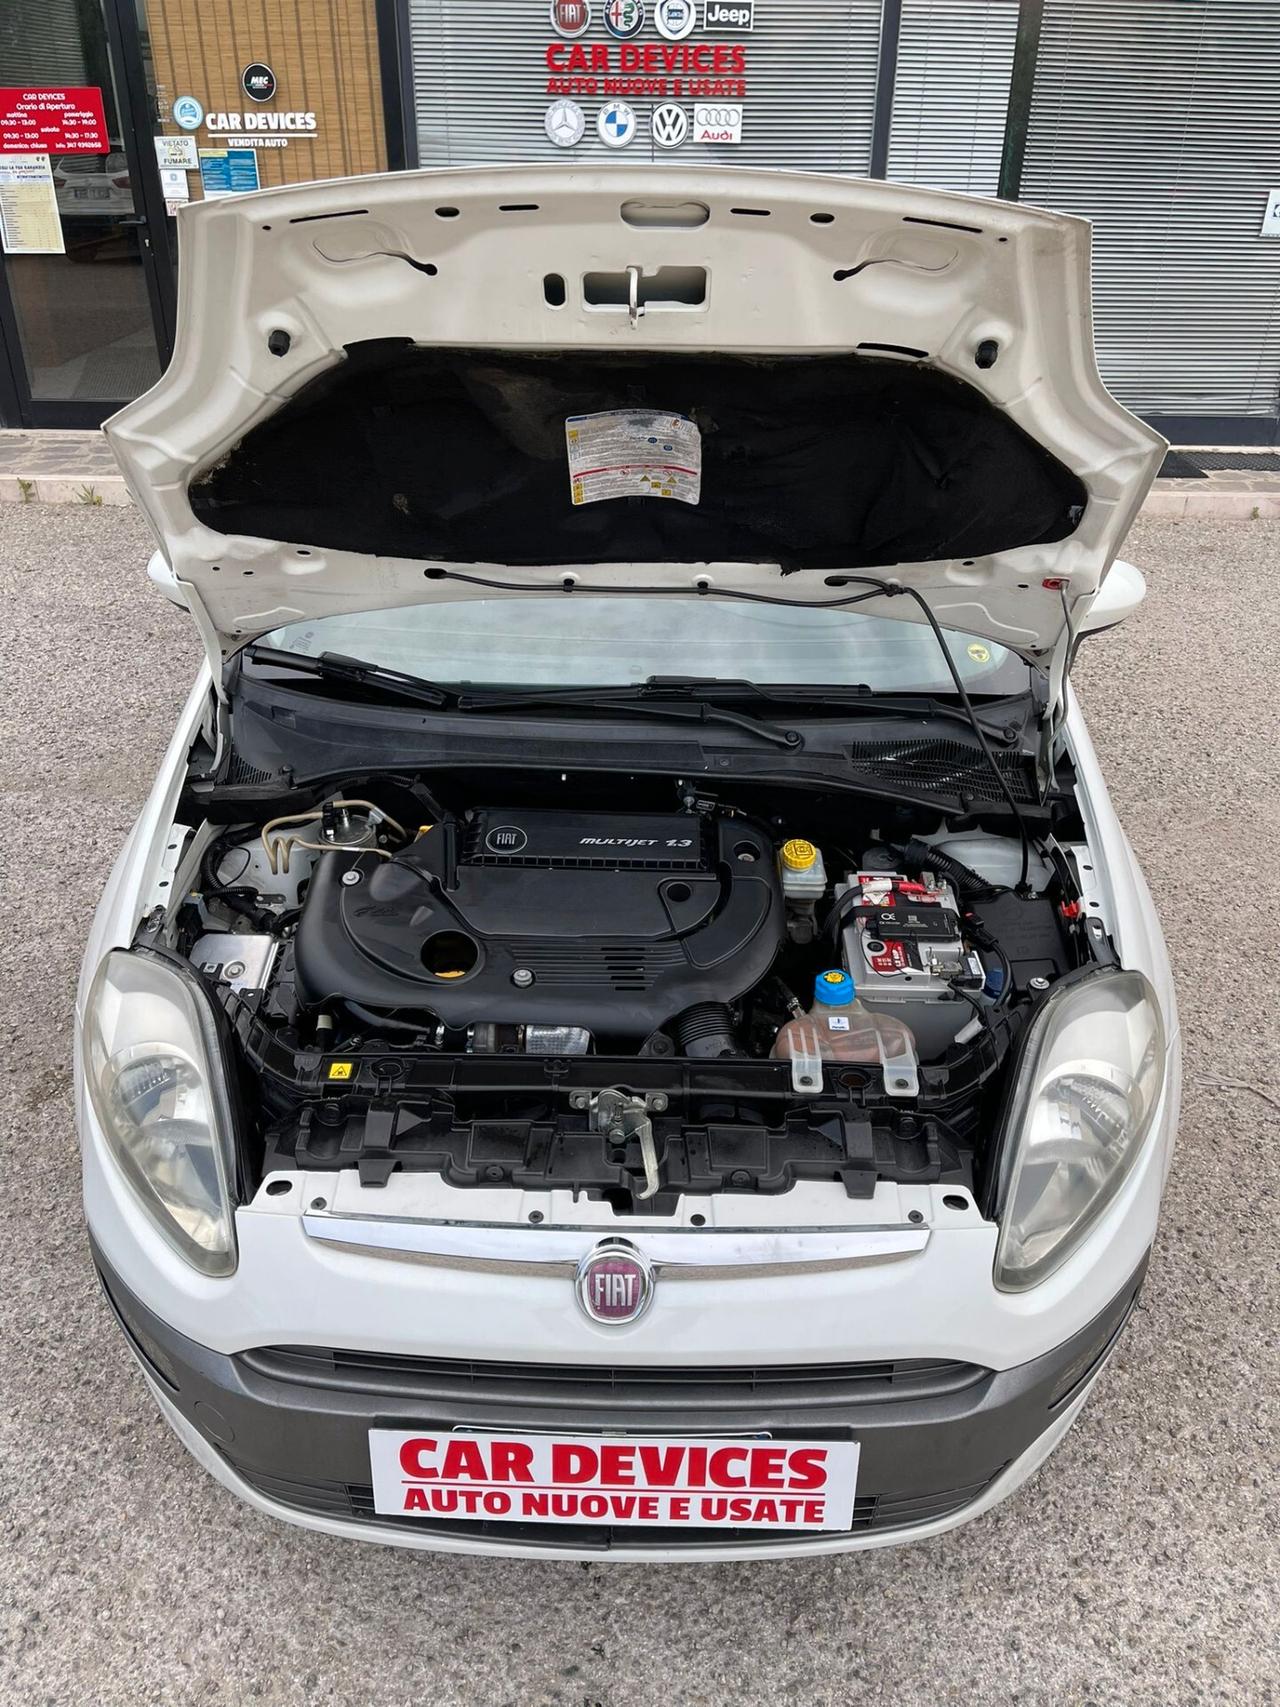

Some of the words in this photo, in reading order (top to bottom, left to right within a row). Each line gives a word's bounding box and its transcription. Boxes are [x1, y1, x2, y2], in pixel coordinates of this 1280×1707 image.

[560, 4, 582, 23] FIAT
[707, 4, 750, 27] Jeep
[545, 43, 610, 73] CAR
[620, 44, 746, 74] DEVICES
[250, 76, 269, 85] MEC
[546, 77, 598, 95] AUTO
[604, 77, 668, 96] NUOVE
[673, 79, 683, 96] E
[688, 79, 746, 96] USATE
[46, 103, 76, 111] Apertura
[205, 112, 242, 130] CAR
[245, 112, 317, 130] DEVICES
[228, 138, 264, 147] VENDITA
[264, 138, 288, 147] AUTO
[701, 129, 733, 141] Audi
[496, 832, 517, 845] FIAT
[579, 837, 659, 847] MULTIJET
[665, 839, 693, 847] 1.3
[595, 1273, 637, 1307] FIAT
[400, 1438, 535, 1482] CAR
[552, 1444, 828, 1490] DEVICES
[403, 1488, 512, 1515] AUTO
[522, 1492, 660, 1519] NUOVE
[669, 1497, 690, 1521] E
[701, 1497, 826, 1523] USATE
